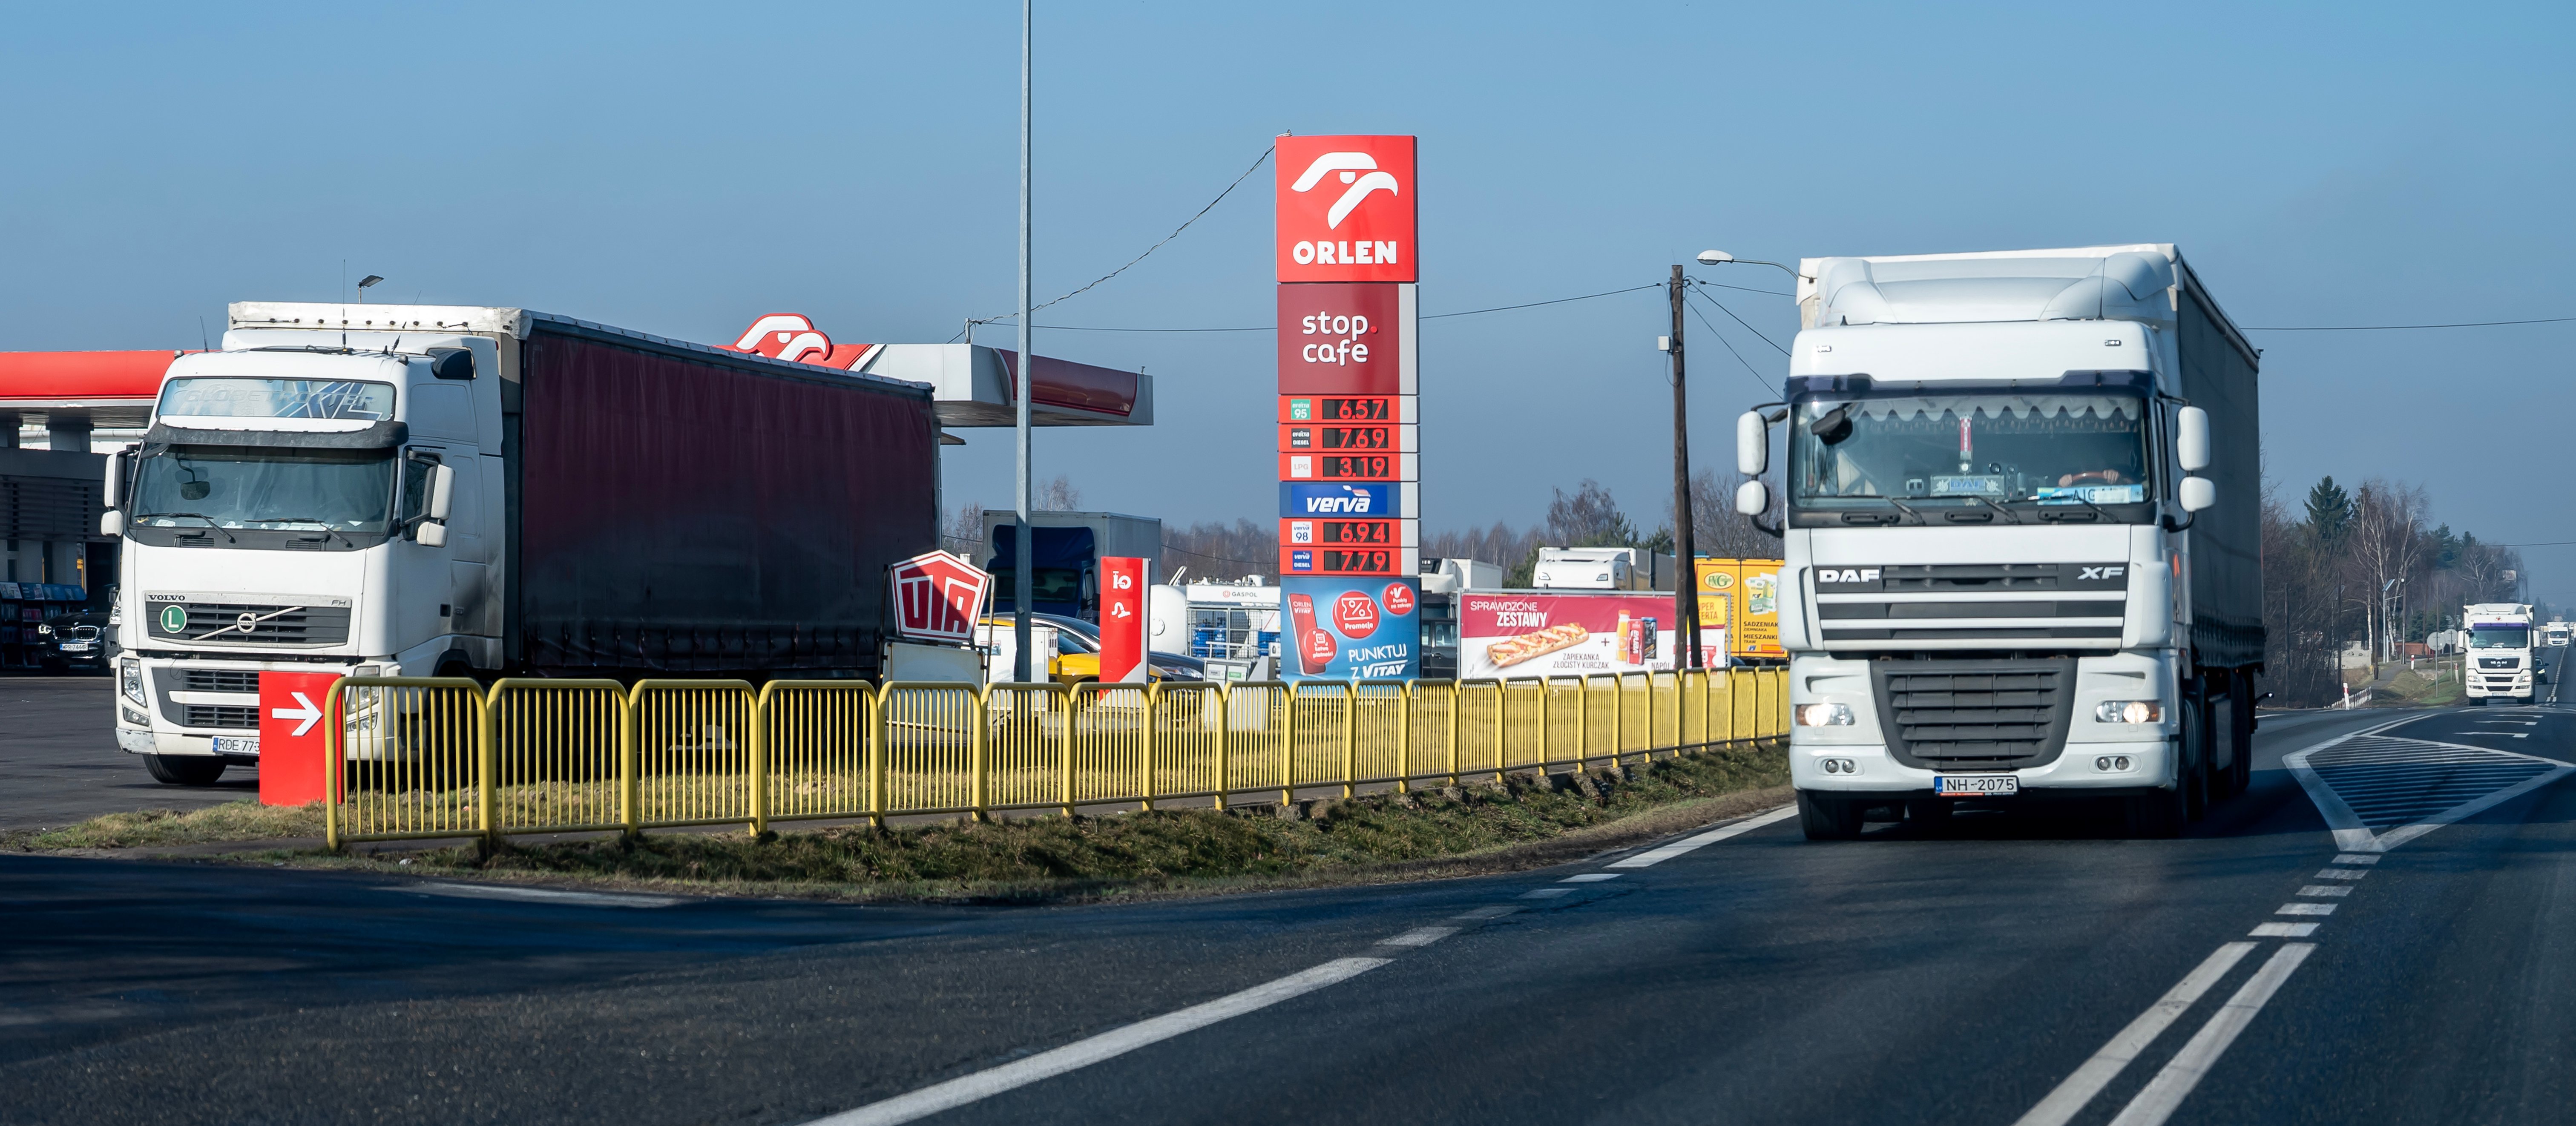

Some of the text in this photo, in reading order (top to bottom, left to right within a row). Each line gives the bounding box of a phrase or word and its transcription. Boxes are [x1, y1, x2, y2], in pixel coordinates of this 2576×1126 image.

[1293, 241, 1397, 265] ORLEN
[1302, 339, 1368, 366] cafe
[184, 390, 377, 407] GLOBETROTTER
[1294, 409, 1307, 419] 95
[1339, 399, 1384, 419] 6.57
[1340, 428, 1385, 448] 7.69
[1340, 457, 1385, 477] 3.19
[1307, 497, 1371, 512] verva
[1296, 532, 1308, 541] 98
[1340, 522, 1386, 543] 6.94
[1342, 551, 1386, 572] 7.79
[1819, 569, 1880, 583] DAF
[2077, 566, 2125, 580] XF
[897, 560, 982, 635] UTA
[1470, 601, 1538, 612] SPRAWDZONE
[168, 611, 179, 628] L
[1496, 612, 1547, 627] ZESTAWY
[1349, 643, 1407, 662] PUNKTUJ
[1651, 661, 1670, 670] NAPÓJ
[218, 739, 239, 750] RDE
